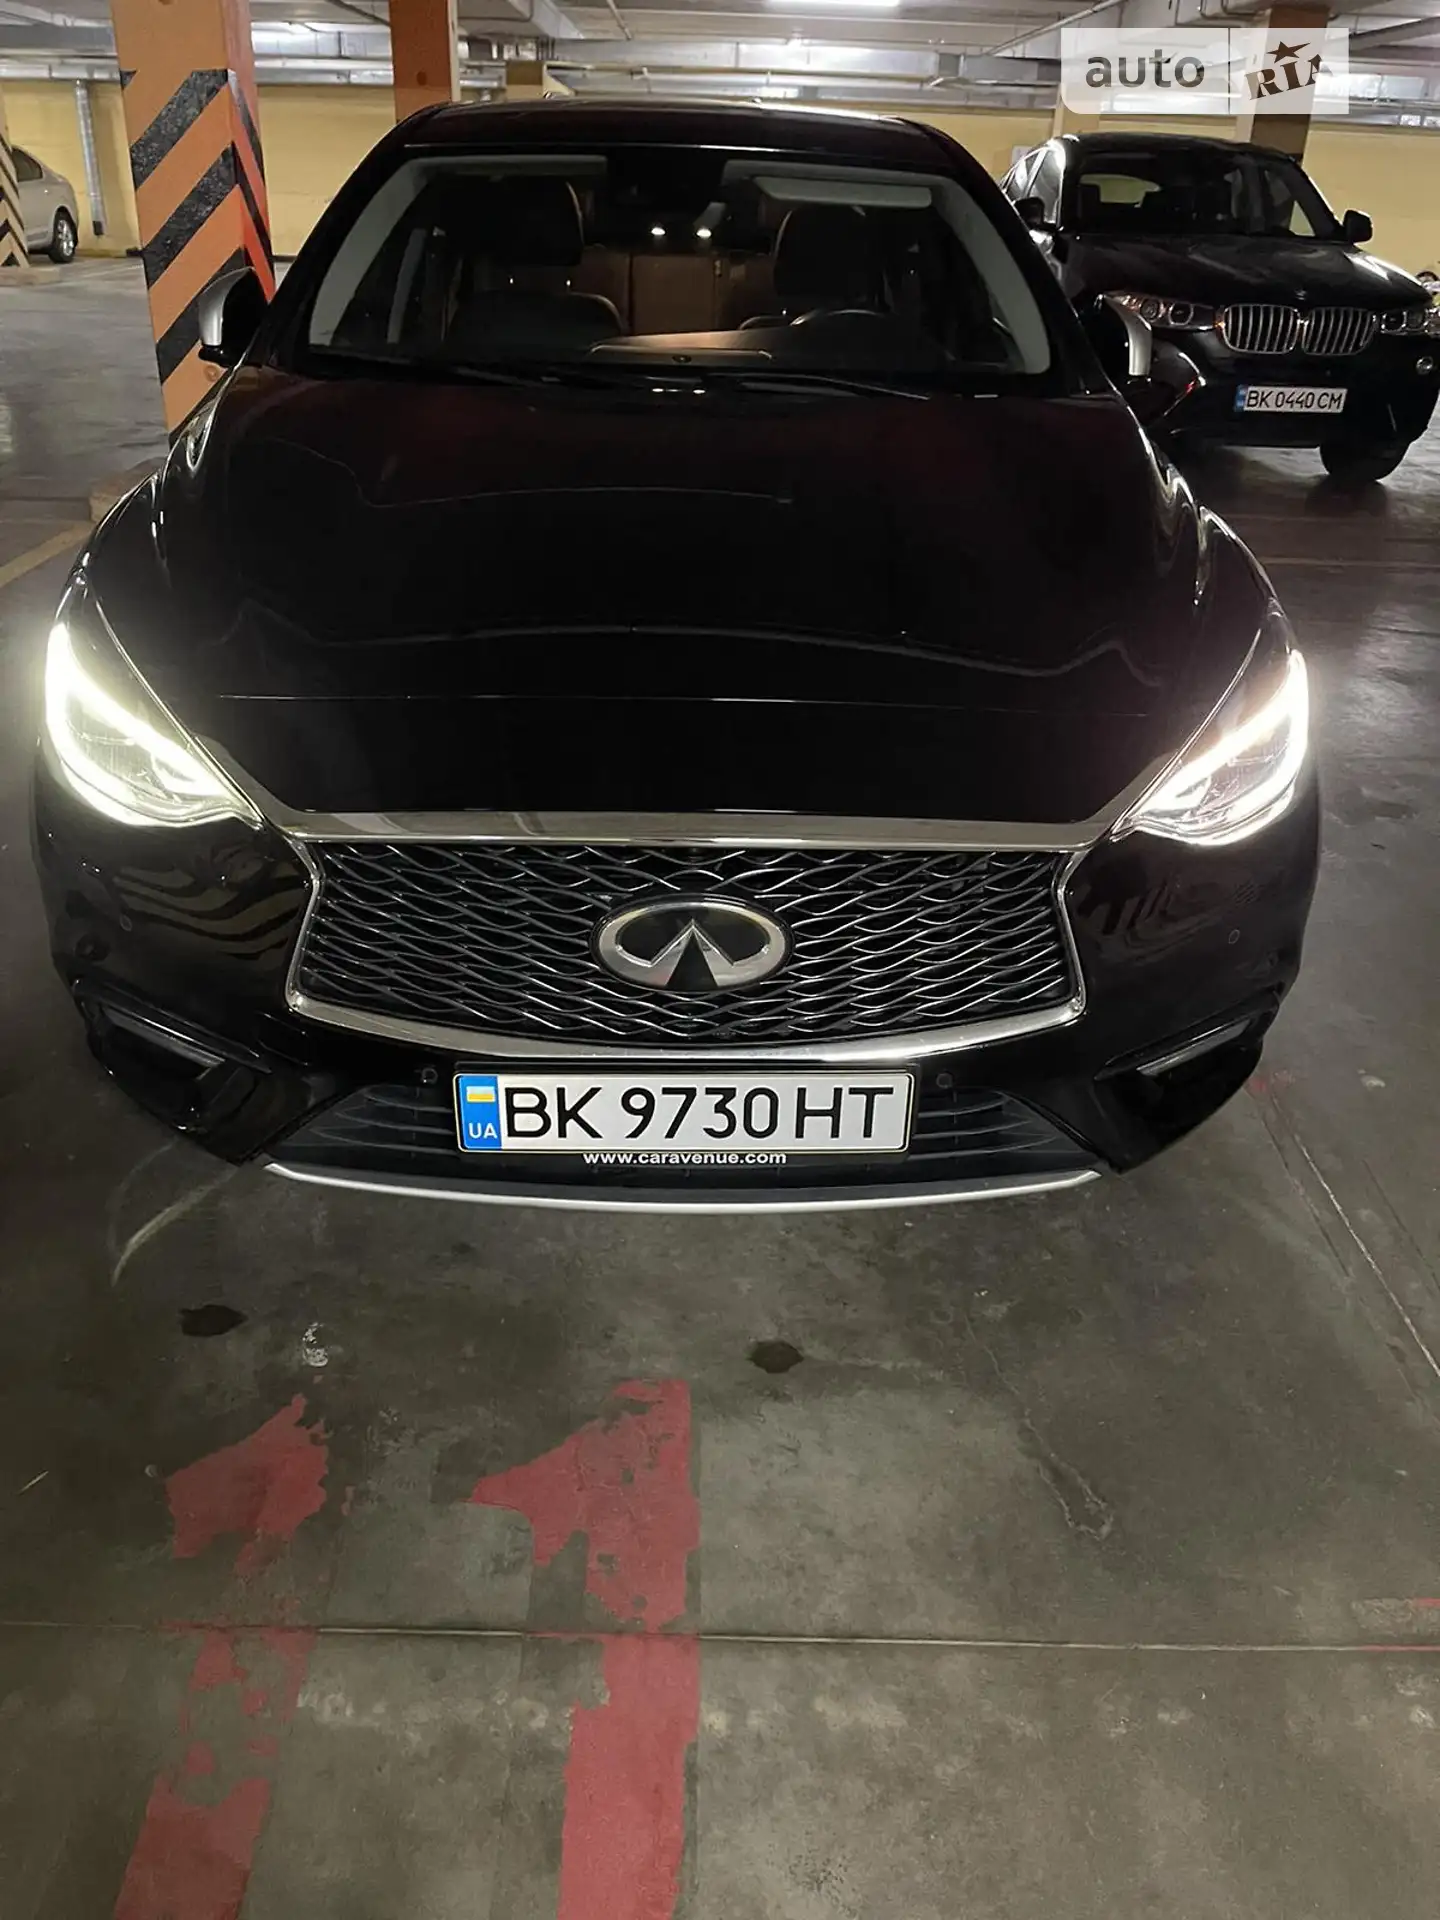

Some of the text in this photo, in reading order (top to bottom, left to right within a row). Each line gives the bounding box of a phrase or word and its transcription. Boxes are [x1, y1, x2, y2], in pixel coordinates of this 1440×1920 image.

[1246, 390, 1343, 410] BK 0440 CM
[505, 1086, 894, 1139] BK 9730 HT
[468, 1122, 498, 1139] UA
[582, 1152, 787, 1165] www.caravenue.com
